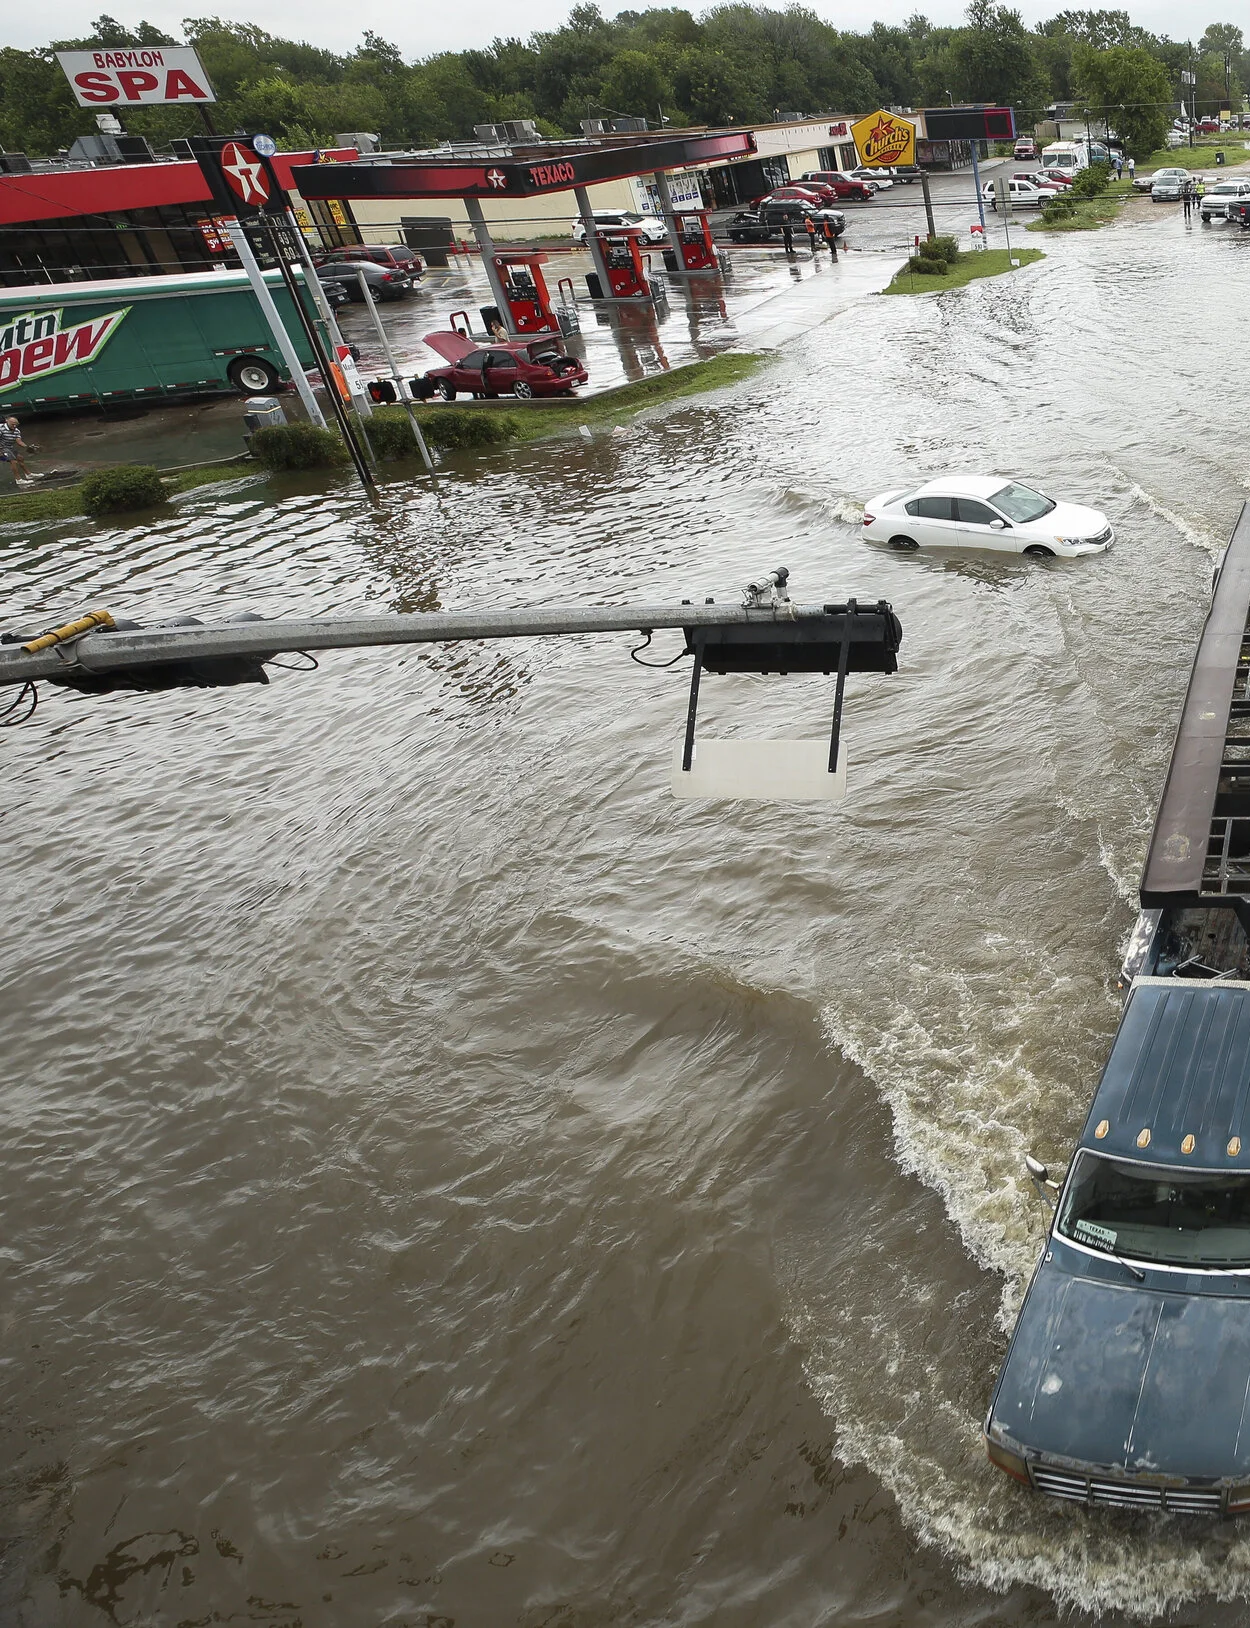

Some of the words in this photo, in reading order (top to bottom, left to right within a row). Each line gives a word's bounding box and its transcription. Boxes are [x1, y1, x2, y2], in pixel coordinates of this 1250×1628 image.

[93, 51, 164, 68] BABYLON
[74, 69, 208, 102] SPA
[861, 126, 910, 162] Church's
[529, 161, 575, 187] TEXACO
